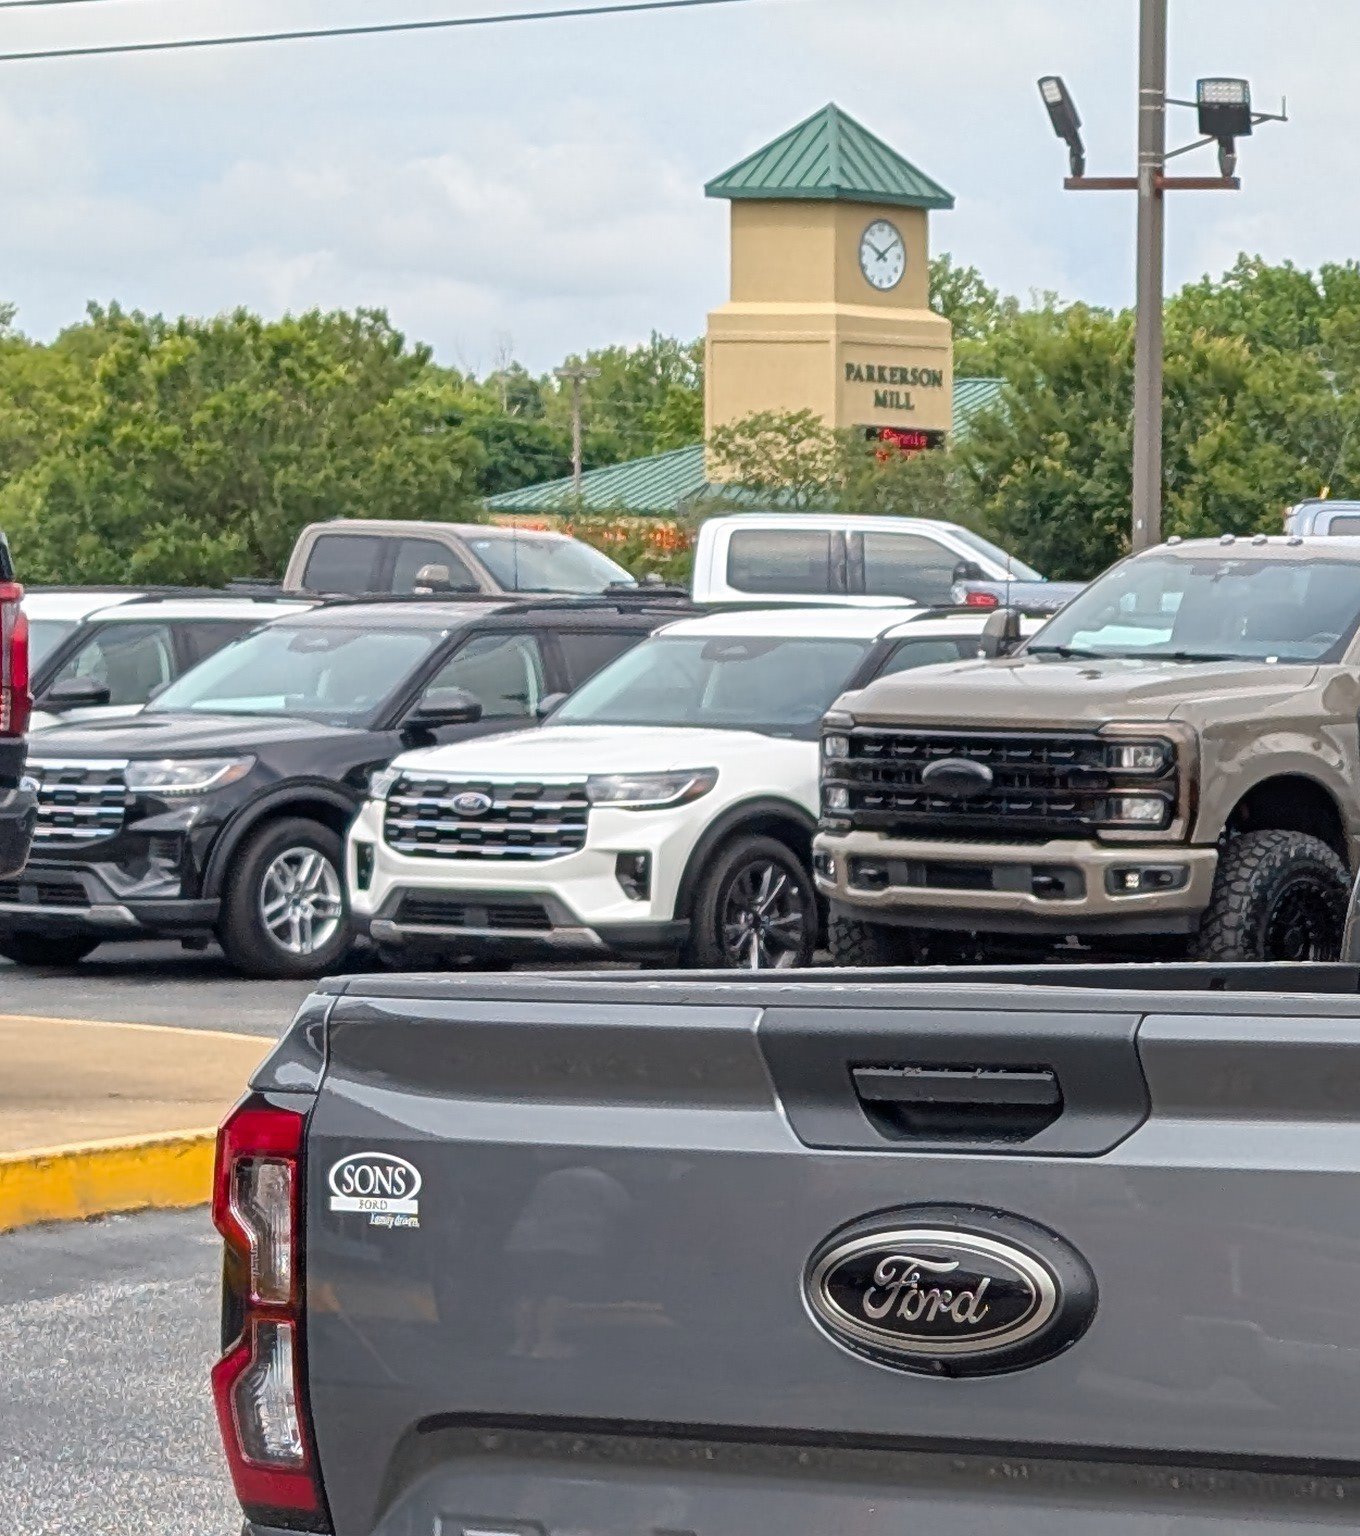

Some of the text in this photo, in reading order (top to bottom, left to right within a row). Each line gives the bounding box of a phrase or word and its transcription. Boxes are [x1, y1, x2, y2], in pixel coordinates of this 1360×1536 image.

[845, 362, 943, 388] PARKERSON
[874, 389, 915, 411] MILL
[342, 1164, 406, 1195] SONS
[358, 1199, 388, 1211] FORD
[862, 1255, 991, 1324] Ford
